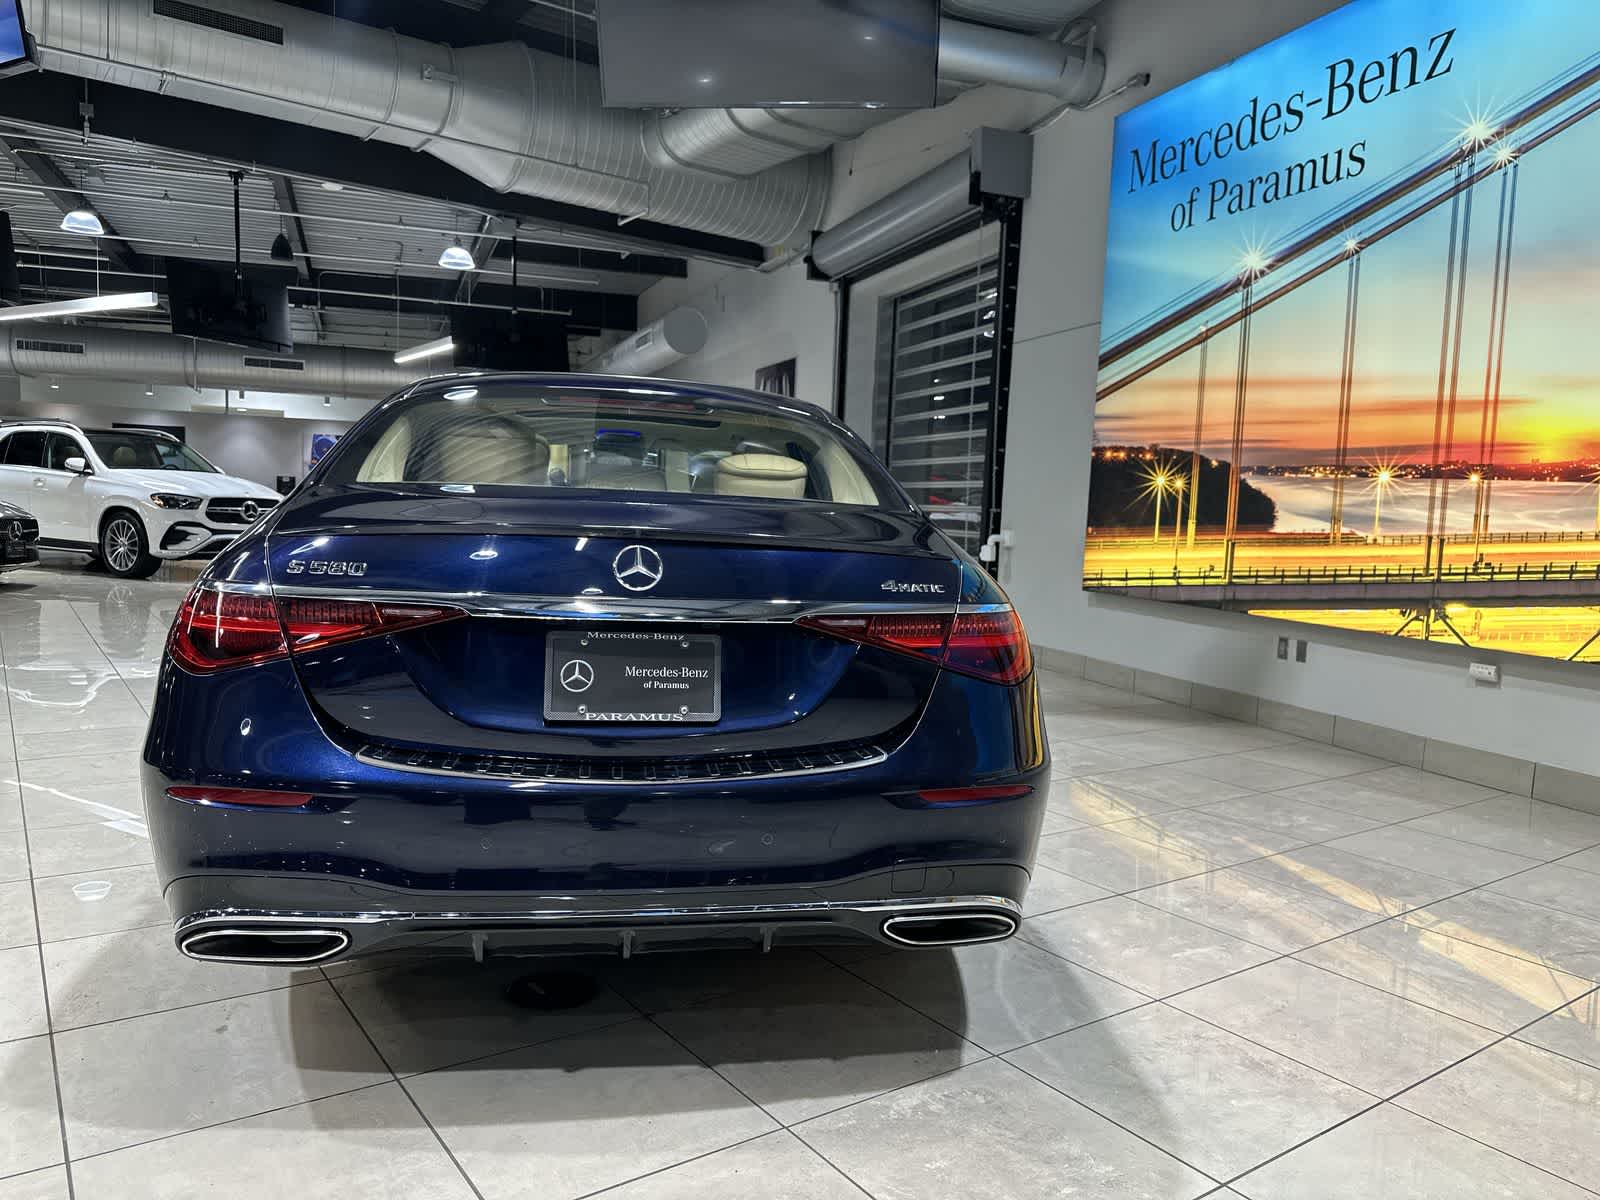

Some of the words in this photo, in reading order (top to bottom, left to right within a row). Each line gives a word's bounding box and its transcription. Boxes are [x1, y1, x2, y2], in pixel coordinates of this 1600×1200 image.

[1127, 27, 1457, 195] Mercedes-Benz
[1170, 187, 1201, 233] of
[1206, 140, 1367, 222] Paramus
[286, 559, 306, 574] S
[308, 560, 368, 576] 580
[880, 579, 946, 593] 4MATIC
[587, 631, 685, 641] Mercedes-Benz
[624, 665, 709, 679] Mercedes-Benz
[643, 680, 652, 689] of
[653, 681, 690, 690] Paramus
[585, 712, 684, 721] PARAMUS
